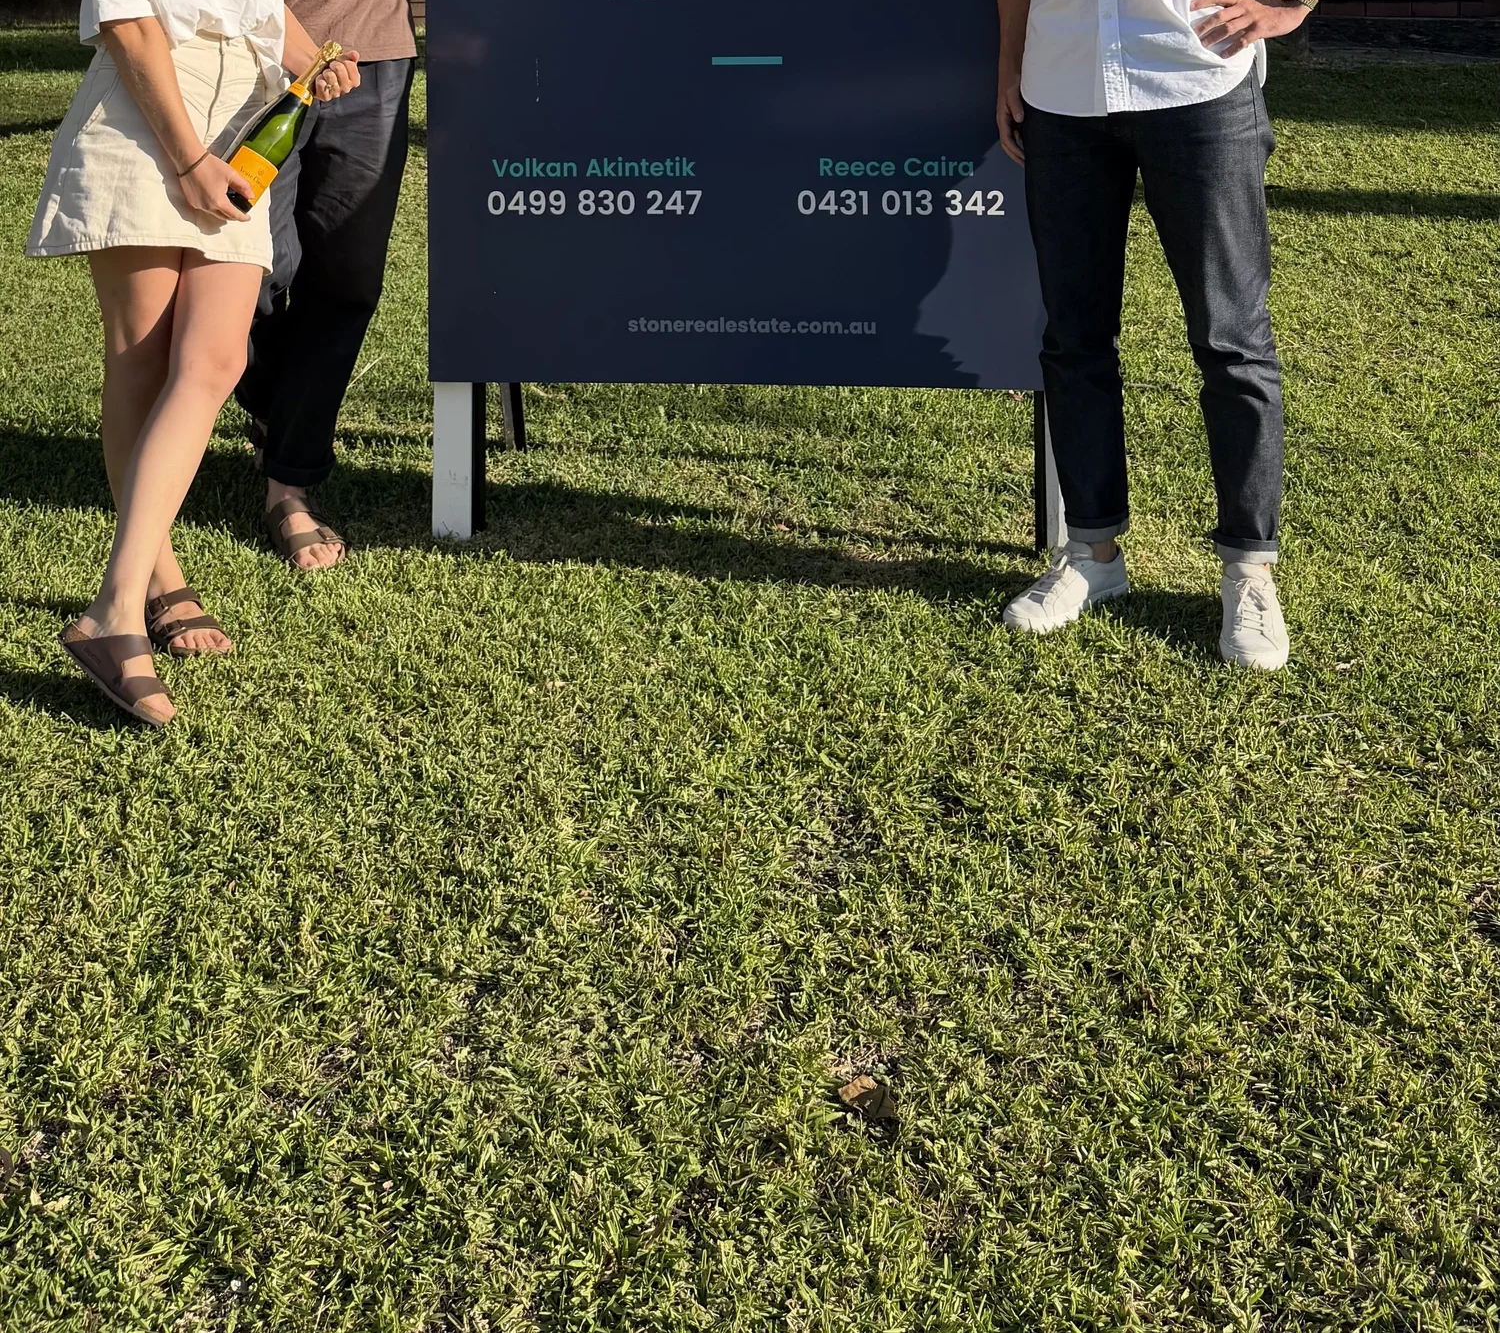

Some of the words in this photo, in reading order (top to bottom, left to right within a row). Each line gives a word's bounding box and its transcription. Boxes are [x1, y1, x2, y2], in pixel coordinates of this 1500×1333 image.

[492, 157, 578, 178] Volkan
[586, 156, 696, 178] Akintetik
[819, 157, 896, 178] Reece
[903, 156, 974, 178] Caira
[487, 190, 567, 216] 0499
[577, 190, 636, 216] 830
[646, 190, 703, 216] 247
[797, 190, 869, 216] 0431
[881, 190, 933, 216] 013
[945, 190, 1006, 216] 342
[627, 316, 877, 336] stonerealestate.com.au
